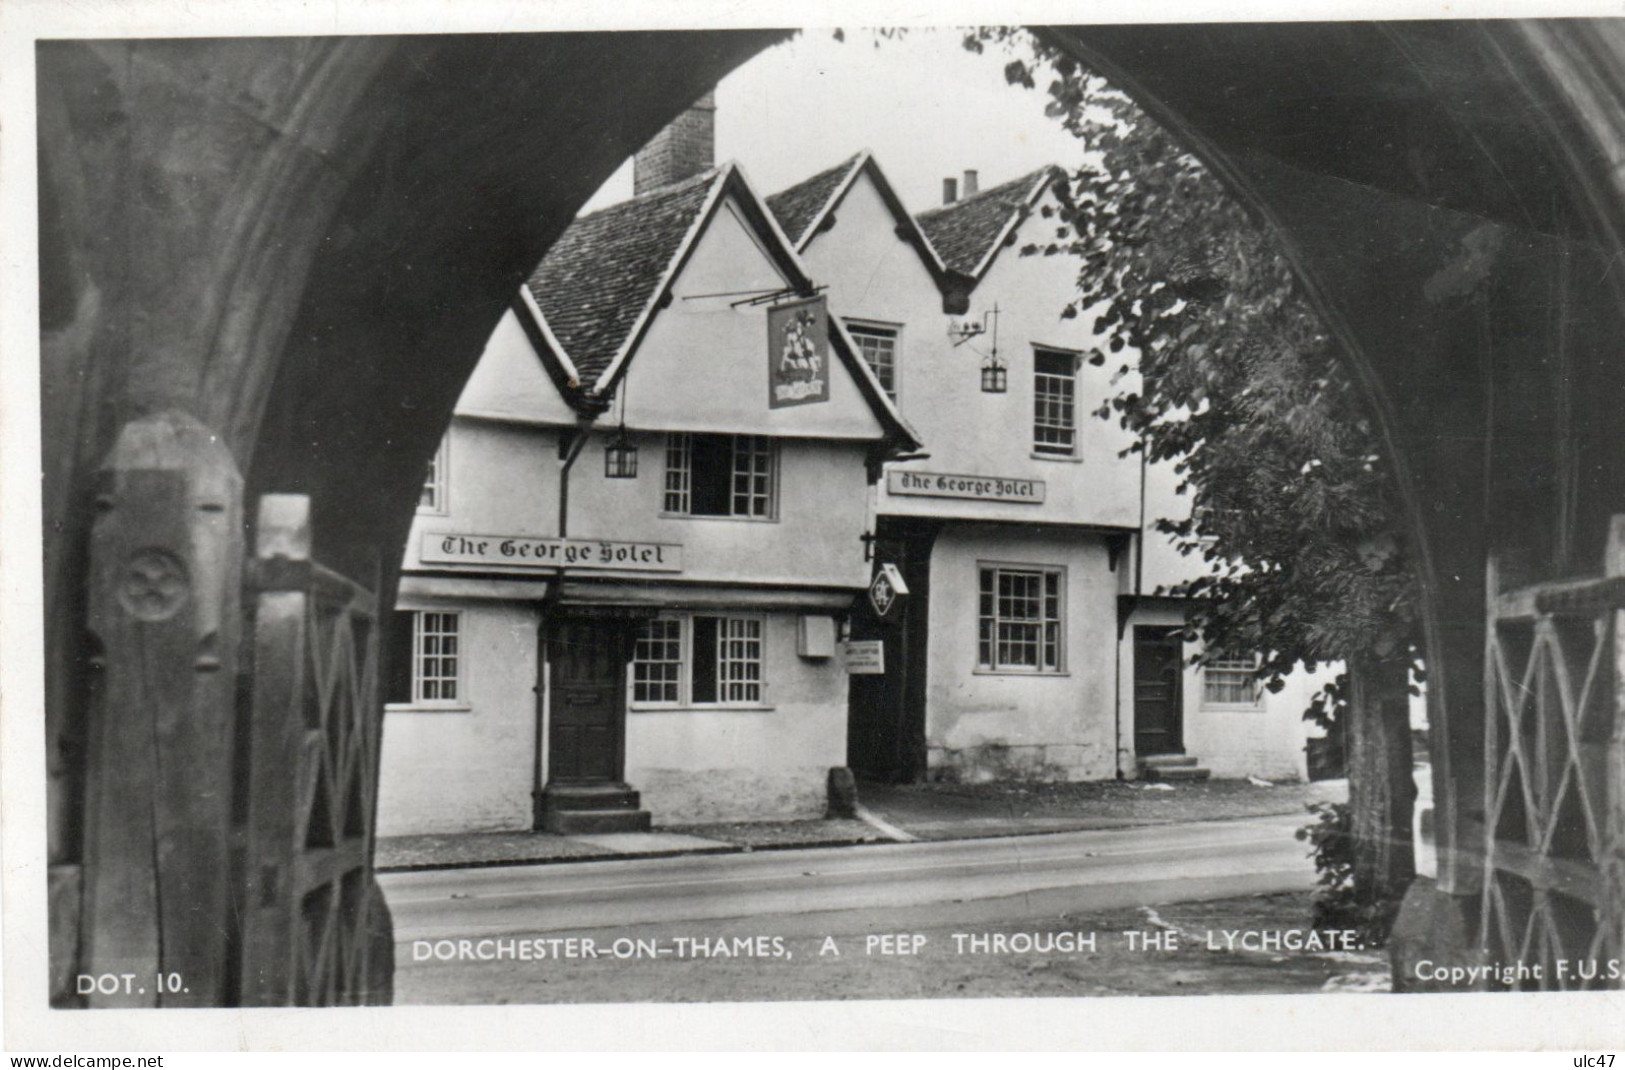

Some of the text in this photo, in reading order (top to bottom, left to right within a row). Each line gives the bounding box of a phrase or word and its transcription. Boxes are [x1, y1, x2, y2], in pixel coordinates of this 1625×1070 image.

[902, 472, 1034, 497] The George Hotel
[441, 536, 664, 564] The George Hotel
